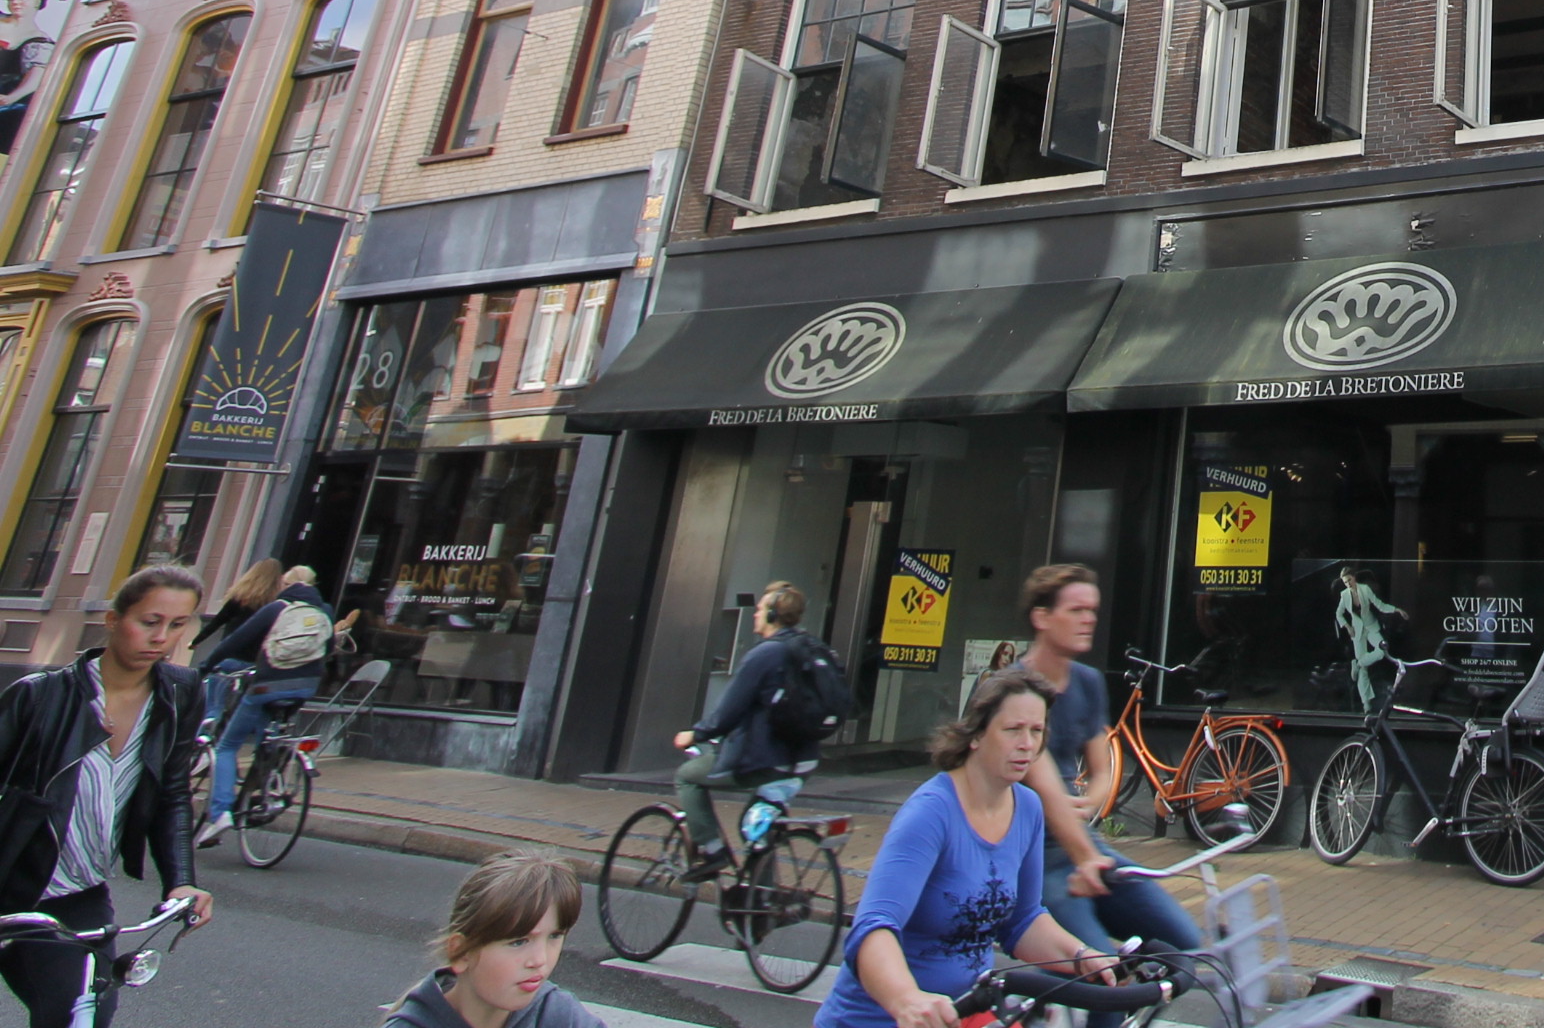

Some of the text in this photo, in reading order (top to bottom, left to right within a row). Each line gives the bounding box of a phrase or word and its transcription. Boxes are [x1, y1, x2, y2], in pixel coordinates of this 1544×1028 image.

[353, 352, 393, 389] 28
[1235, 372, 1465, 401] FRED DE LA BRETONIERE
[212, 413, 264, 425] BAKKERIJ
[708, 404, 878, 425] FRED DE LA BRETONIERE
[190, 421, 276, 438] BLANCHE
[1206, 467, 1267, 493] VERHUURD
[1236, 536, 1265, 544] feenstra
[422, 545, 487, 561] BAKKERIJ
[396, 564, 500, 591] BLANCHE
[899, 552, 947, 591] VERHUURD
[1200, 569, 1263, 584] 050 311 30 31
[1452, 597, 1523, 616] WIJ ZIJN
[1443, 617, 1534, 633] GESLOTEN
[883, 647, 936, 663] 050 311 30 31
[1461, 658, 1479, 666] SHOP
[1492, 659, 1517, 667] ONLINE
